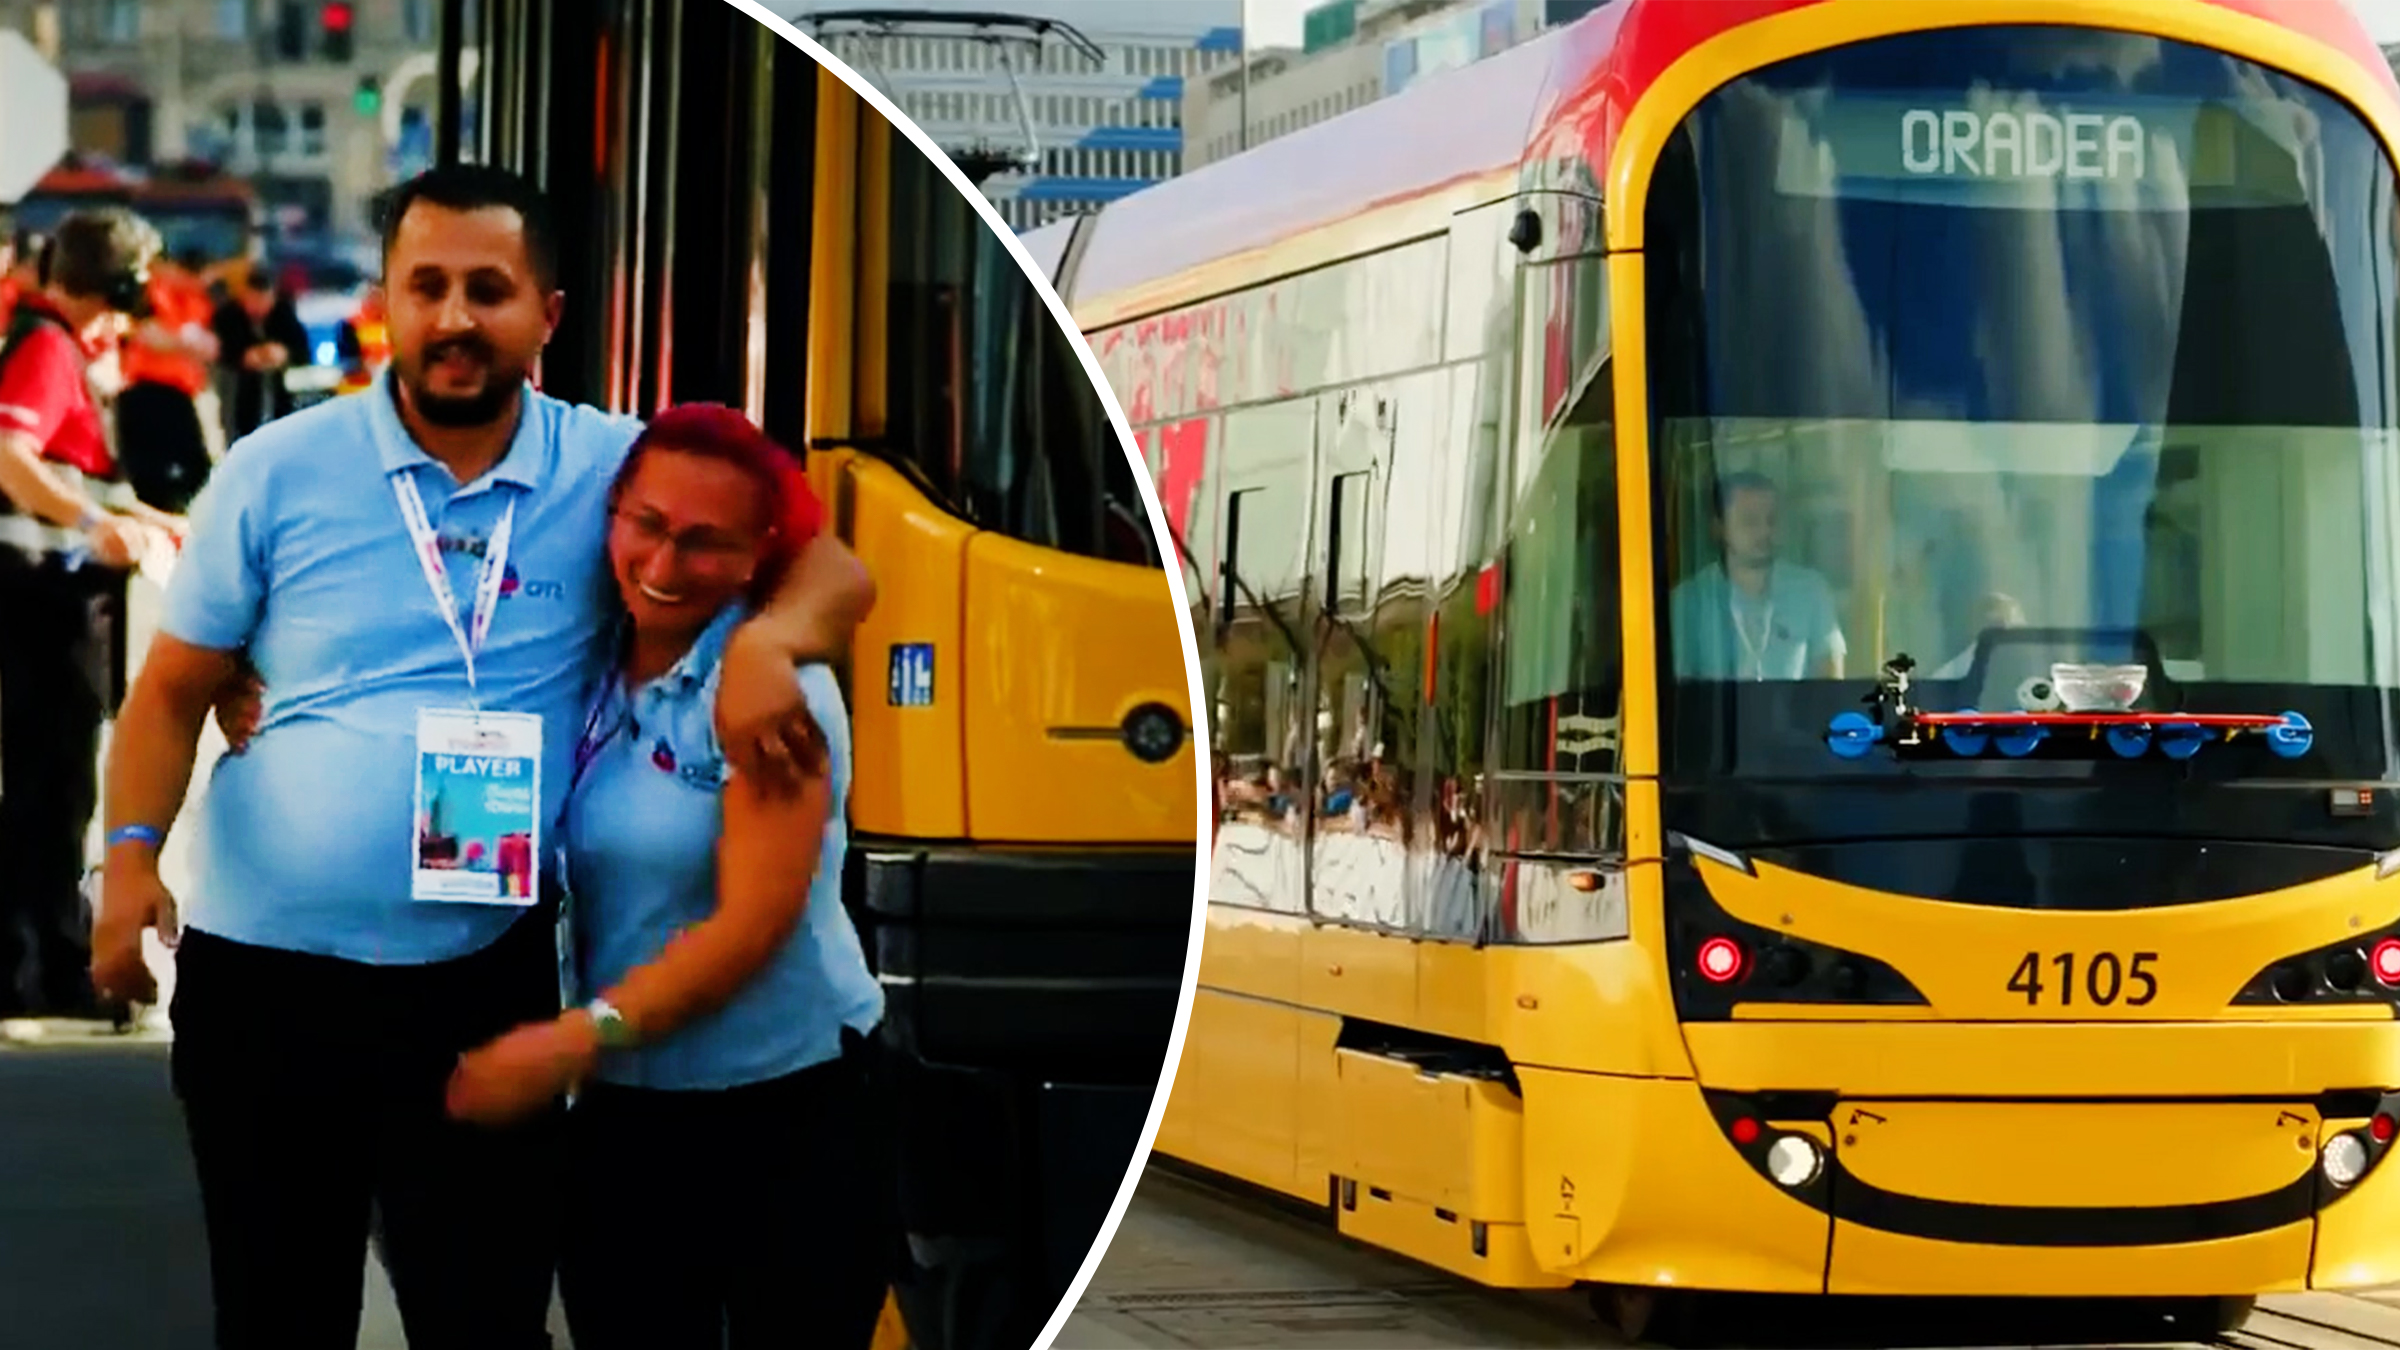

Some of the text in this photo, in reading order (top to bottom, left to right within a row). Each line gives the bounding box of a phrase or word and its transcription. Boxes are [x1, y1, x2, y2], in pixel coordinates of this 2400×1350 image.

[1902, 109, 2145, 179] ORADEA
[434, 756, 521, 777] PLAYER
[2006, 951, 2159, 1007] 4105
